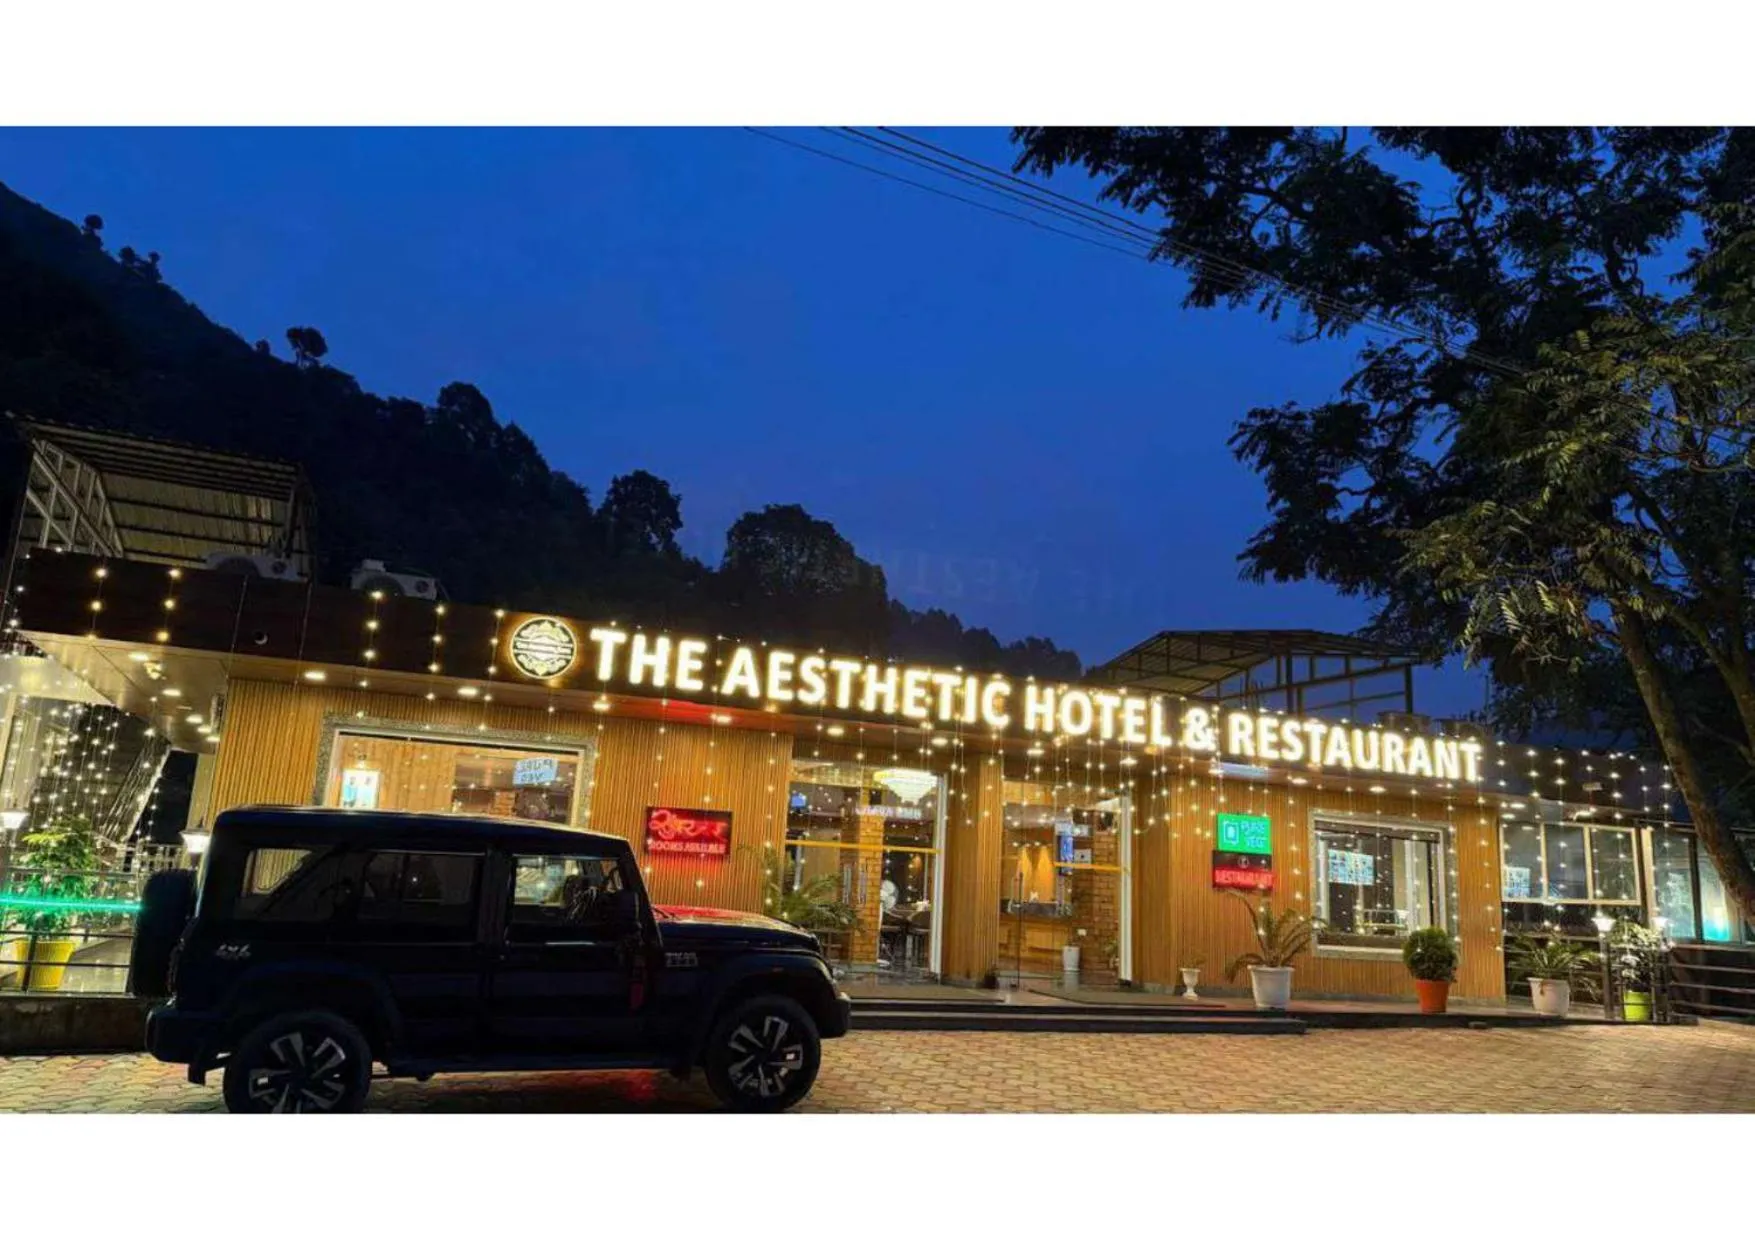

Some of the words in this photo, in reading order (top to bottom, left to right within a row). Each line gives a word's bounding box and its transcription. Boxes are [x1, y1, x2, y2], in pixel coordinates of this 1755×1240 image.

[590, 628, 708, 691] THE
[720, 647, 1010, 729] AESTHETIC
[1025, 685, 1171, 747] HOTEL
[1185, 707, 1216, 750] &
[1228, 712, 1482, 783] RESTAURANT
